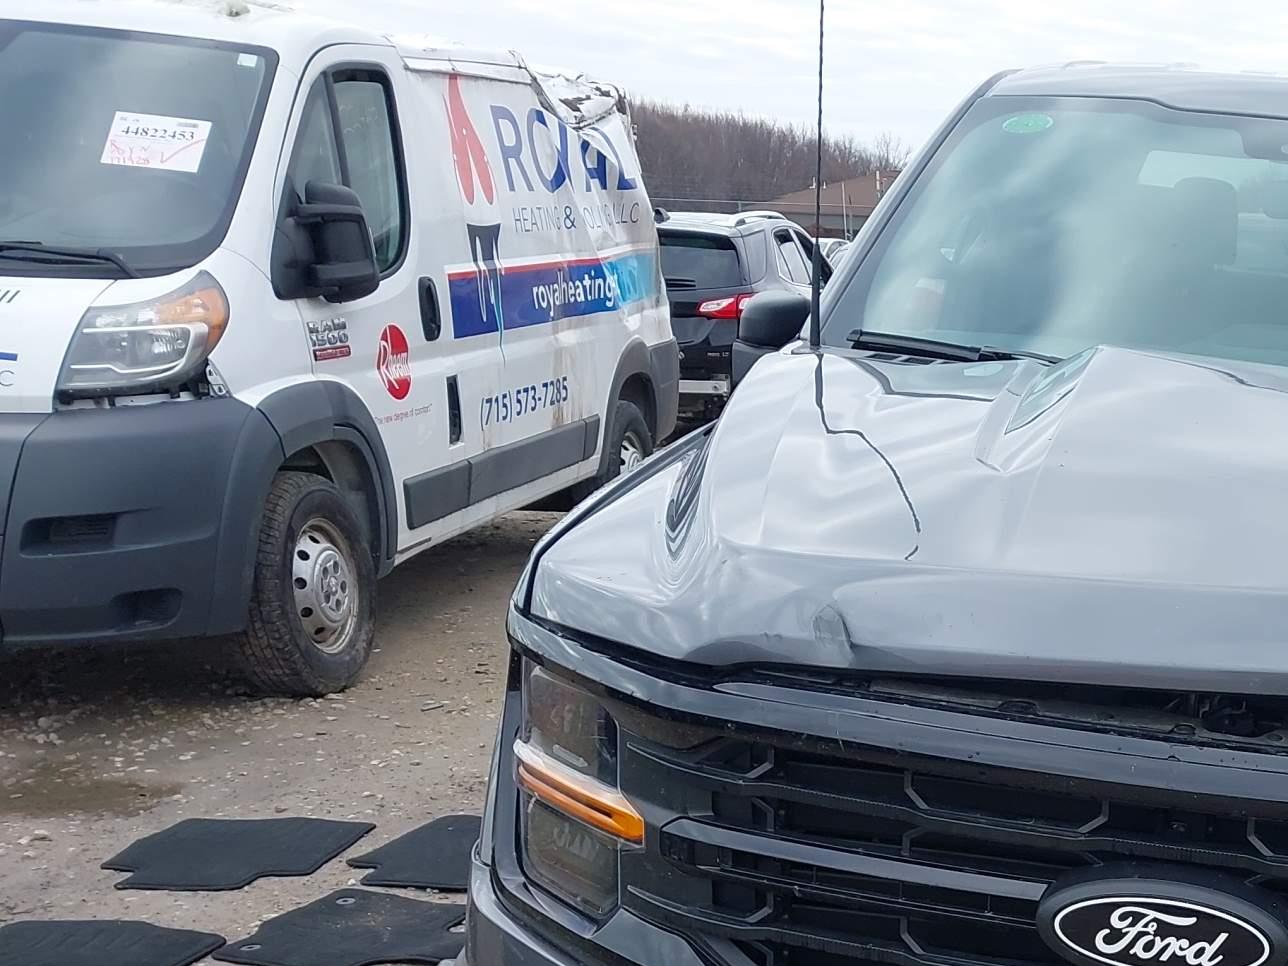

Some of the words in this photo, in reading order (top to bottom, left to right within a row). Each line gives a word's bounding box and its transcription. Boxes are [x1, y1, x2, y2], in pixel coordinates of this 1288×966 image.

[121, 126, 195, 142] 44822453
[564, 206, 577, 230] &
[307, 317, 347, 334] RAM
[311, 331, 349, 347] 1500
[481, 390, 513, 432] (715)
[516, 376, 568, 417] 573-7285
[1095, 906, 1230, 966] Ford
